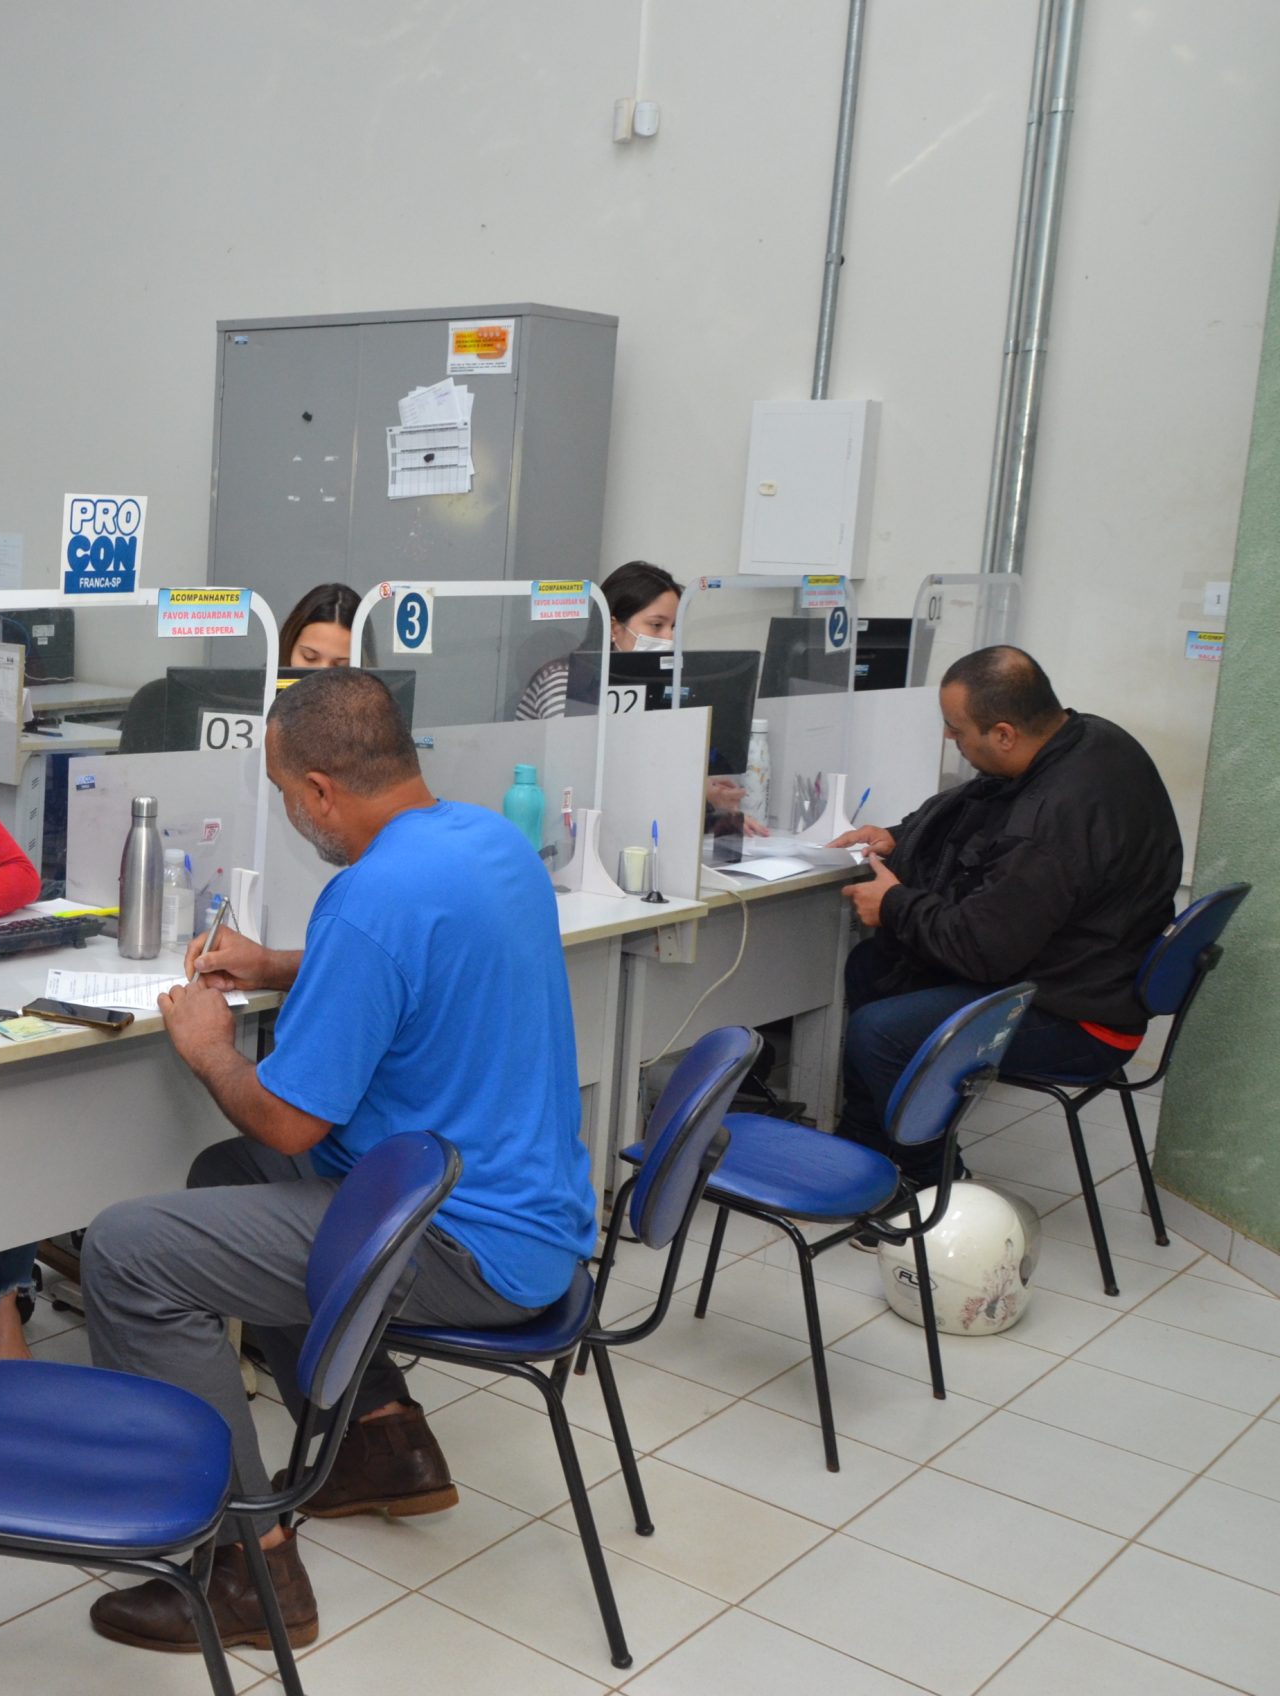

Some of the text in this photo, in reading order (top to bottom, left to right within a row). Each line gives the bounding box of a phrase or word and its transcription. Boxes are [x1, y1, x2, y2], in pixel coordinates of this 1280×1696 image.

[70, 498, 141, 536] PRO
[67, 534, 137, 572] CON
[79, 576, 122, 588] FRANCA-SP
[170, 593, 240, 602] ACOMPANHANTES
[928, 596, 942, 621] 01
[162, 611, 244, 620] FAVOR AGUARDAR NA
[405, 601, 421, 640] 3
[834, 611, 844, 640] 2
[171, 626, 234, 635] SALA DE ESPERA
[206, 717, 254, 750] 03
